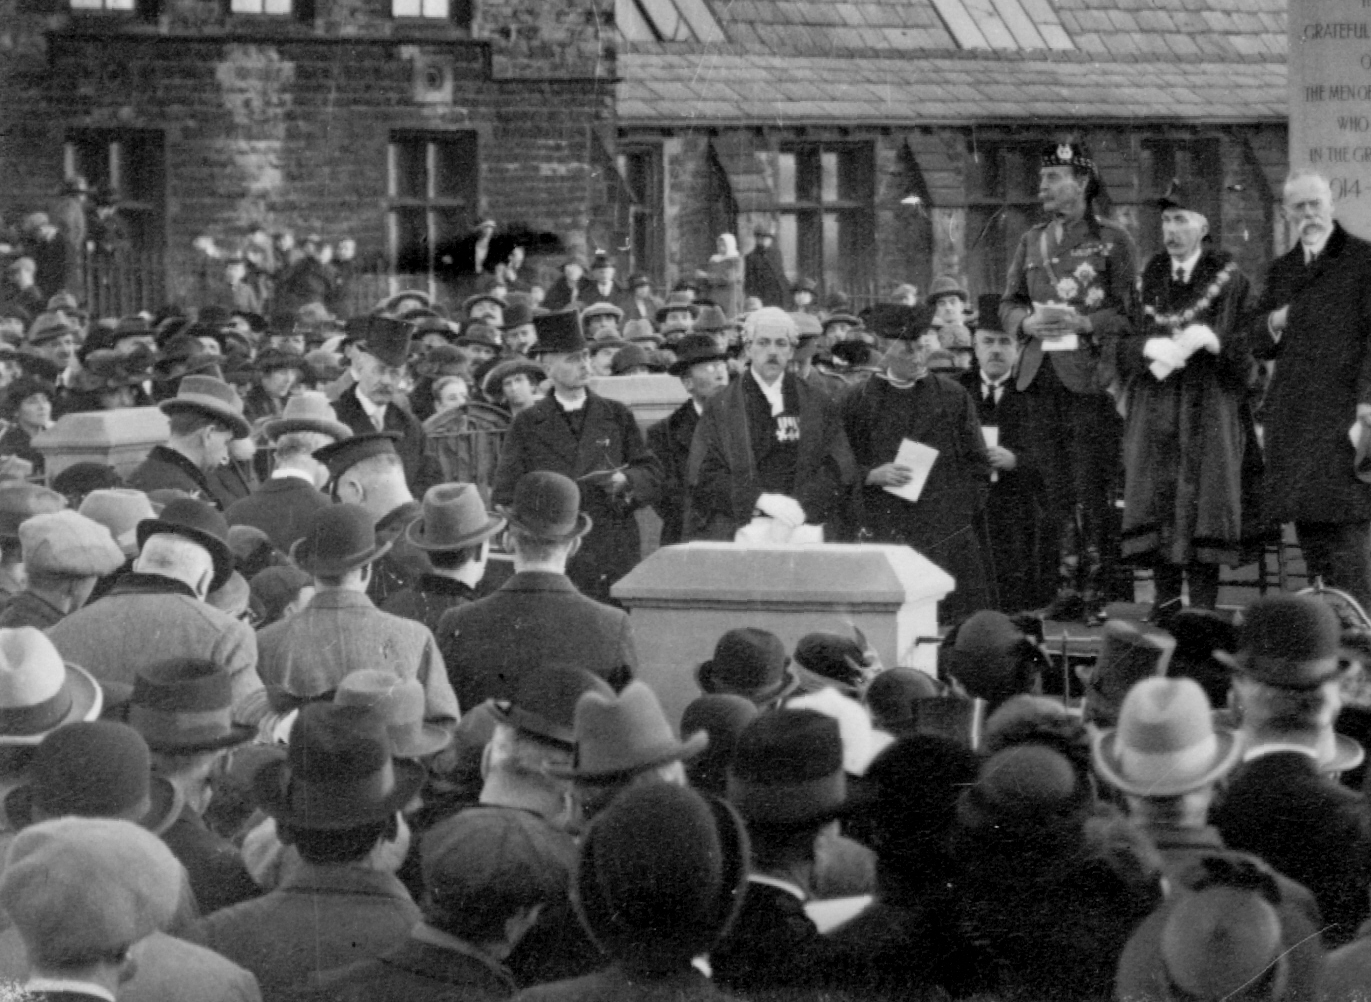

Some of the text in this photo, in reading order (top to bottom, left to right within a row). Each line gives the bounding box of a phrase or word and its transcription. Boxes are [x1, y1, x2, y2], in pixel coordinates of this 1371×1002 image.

[1303, 22, 1371, 39] GRATEFUL
[1305, 85, 1325, 102] THE
[1329, 85, 1354, 101] MEN
[1337, 116, 1369, 132] WHO
[1310, 146, 1323, 163] IN
[1328, 146, 1349, 162] THE
[1328, 178, 1361, 199] 914
